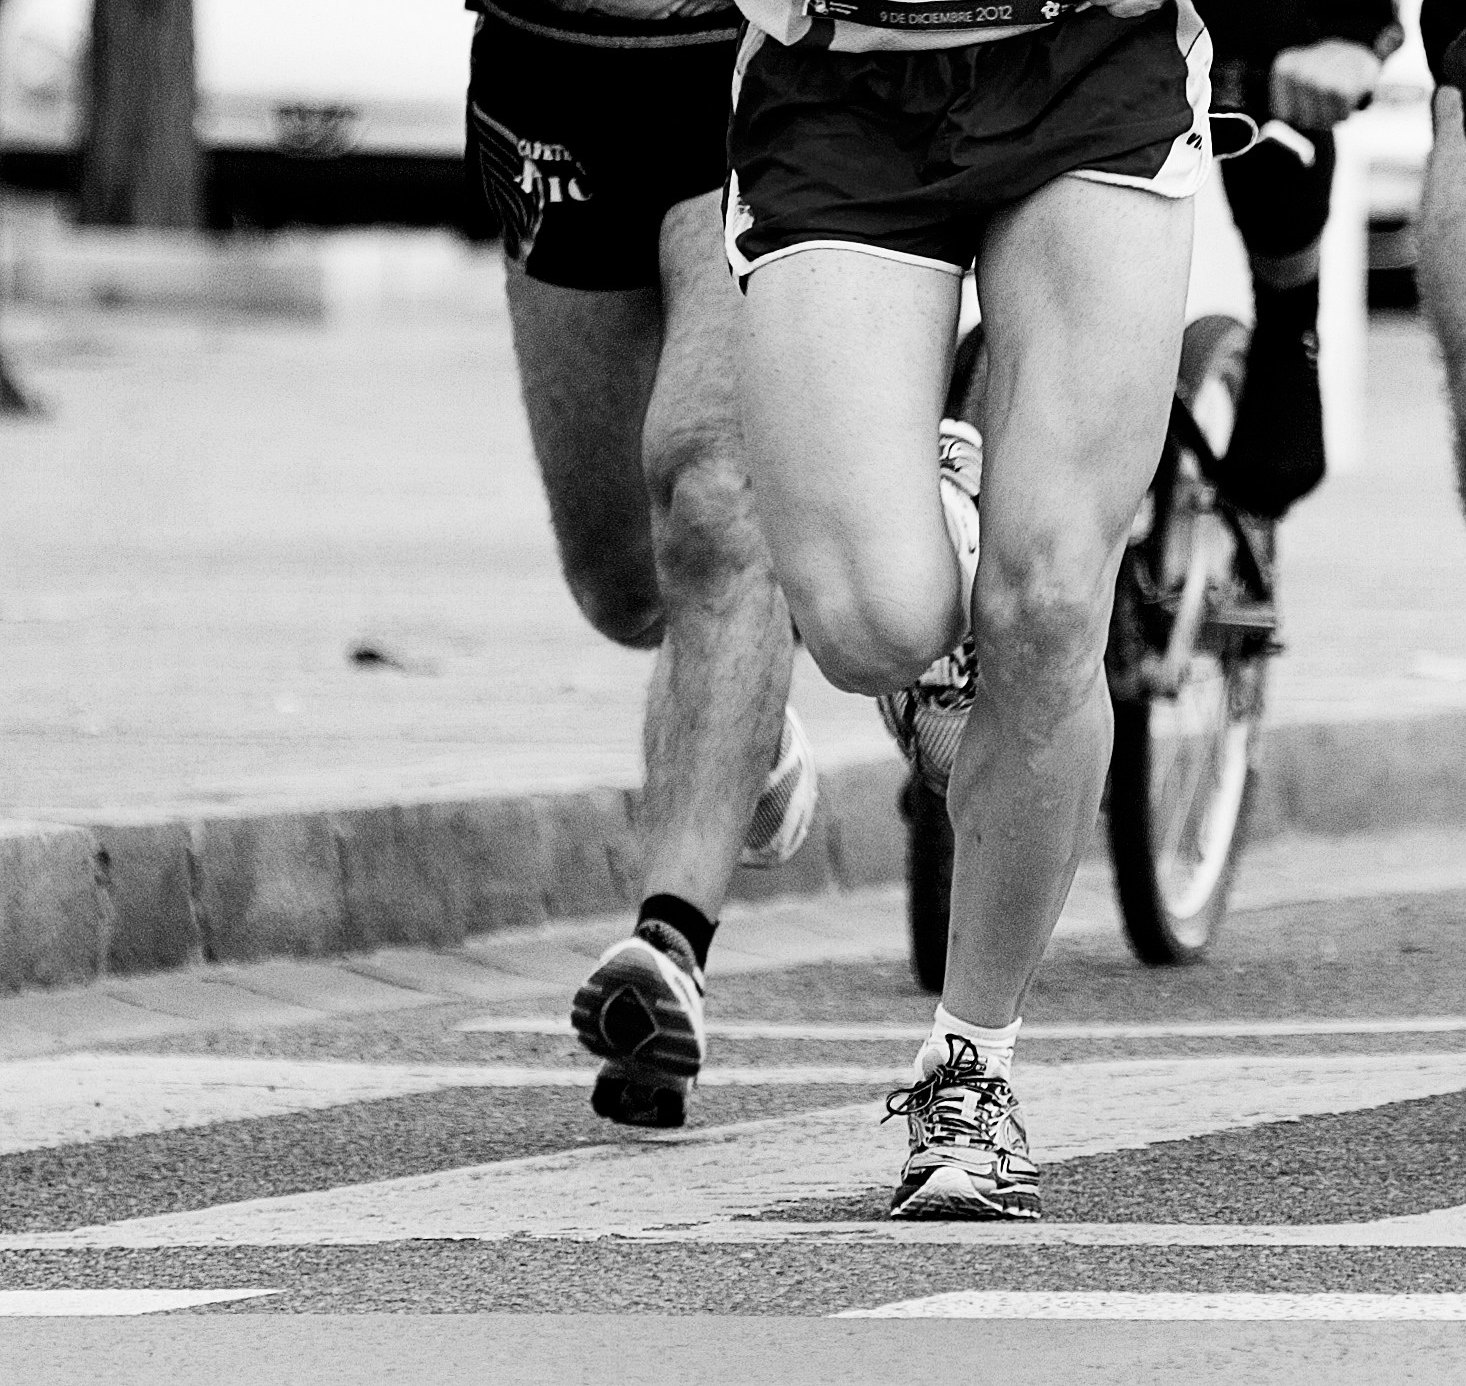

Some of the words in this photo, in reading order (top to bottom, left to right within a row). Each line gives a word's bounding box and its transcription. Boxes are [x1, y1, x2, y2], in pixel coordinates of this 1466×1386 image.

[879, 10, 888, 22] 9
[889, 11, 906, 24] DE
[908, 10, 973, 25] DICIEMBRE
[975, 5, 1013, 21] 2012
